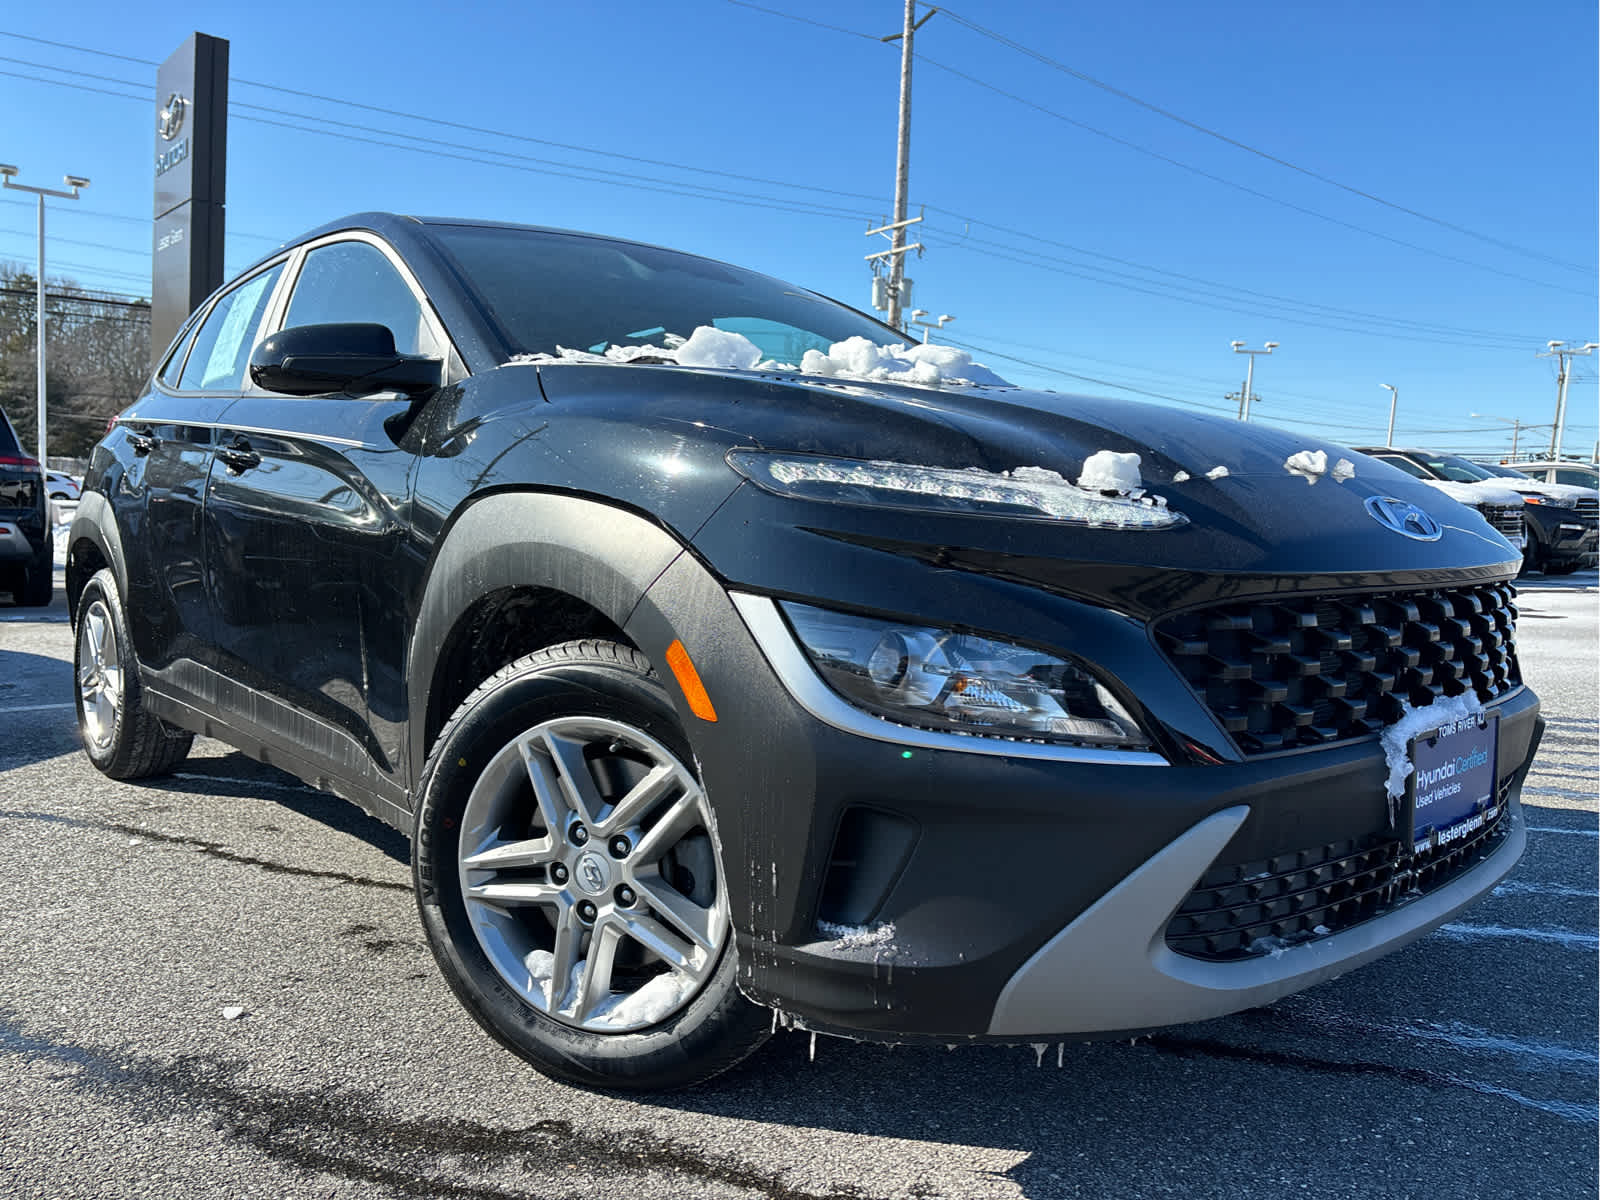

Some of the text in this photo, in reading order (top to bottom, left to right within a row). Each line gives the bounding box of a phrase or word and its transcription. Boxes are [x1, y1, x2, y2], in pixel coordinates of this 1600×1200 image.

[1416, 746, 1488, 790] Hyundai Certified
[1415, 783, 1461, 808] Used Vehicles
